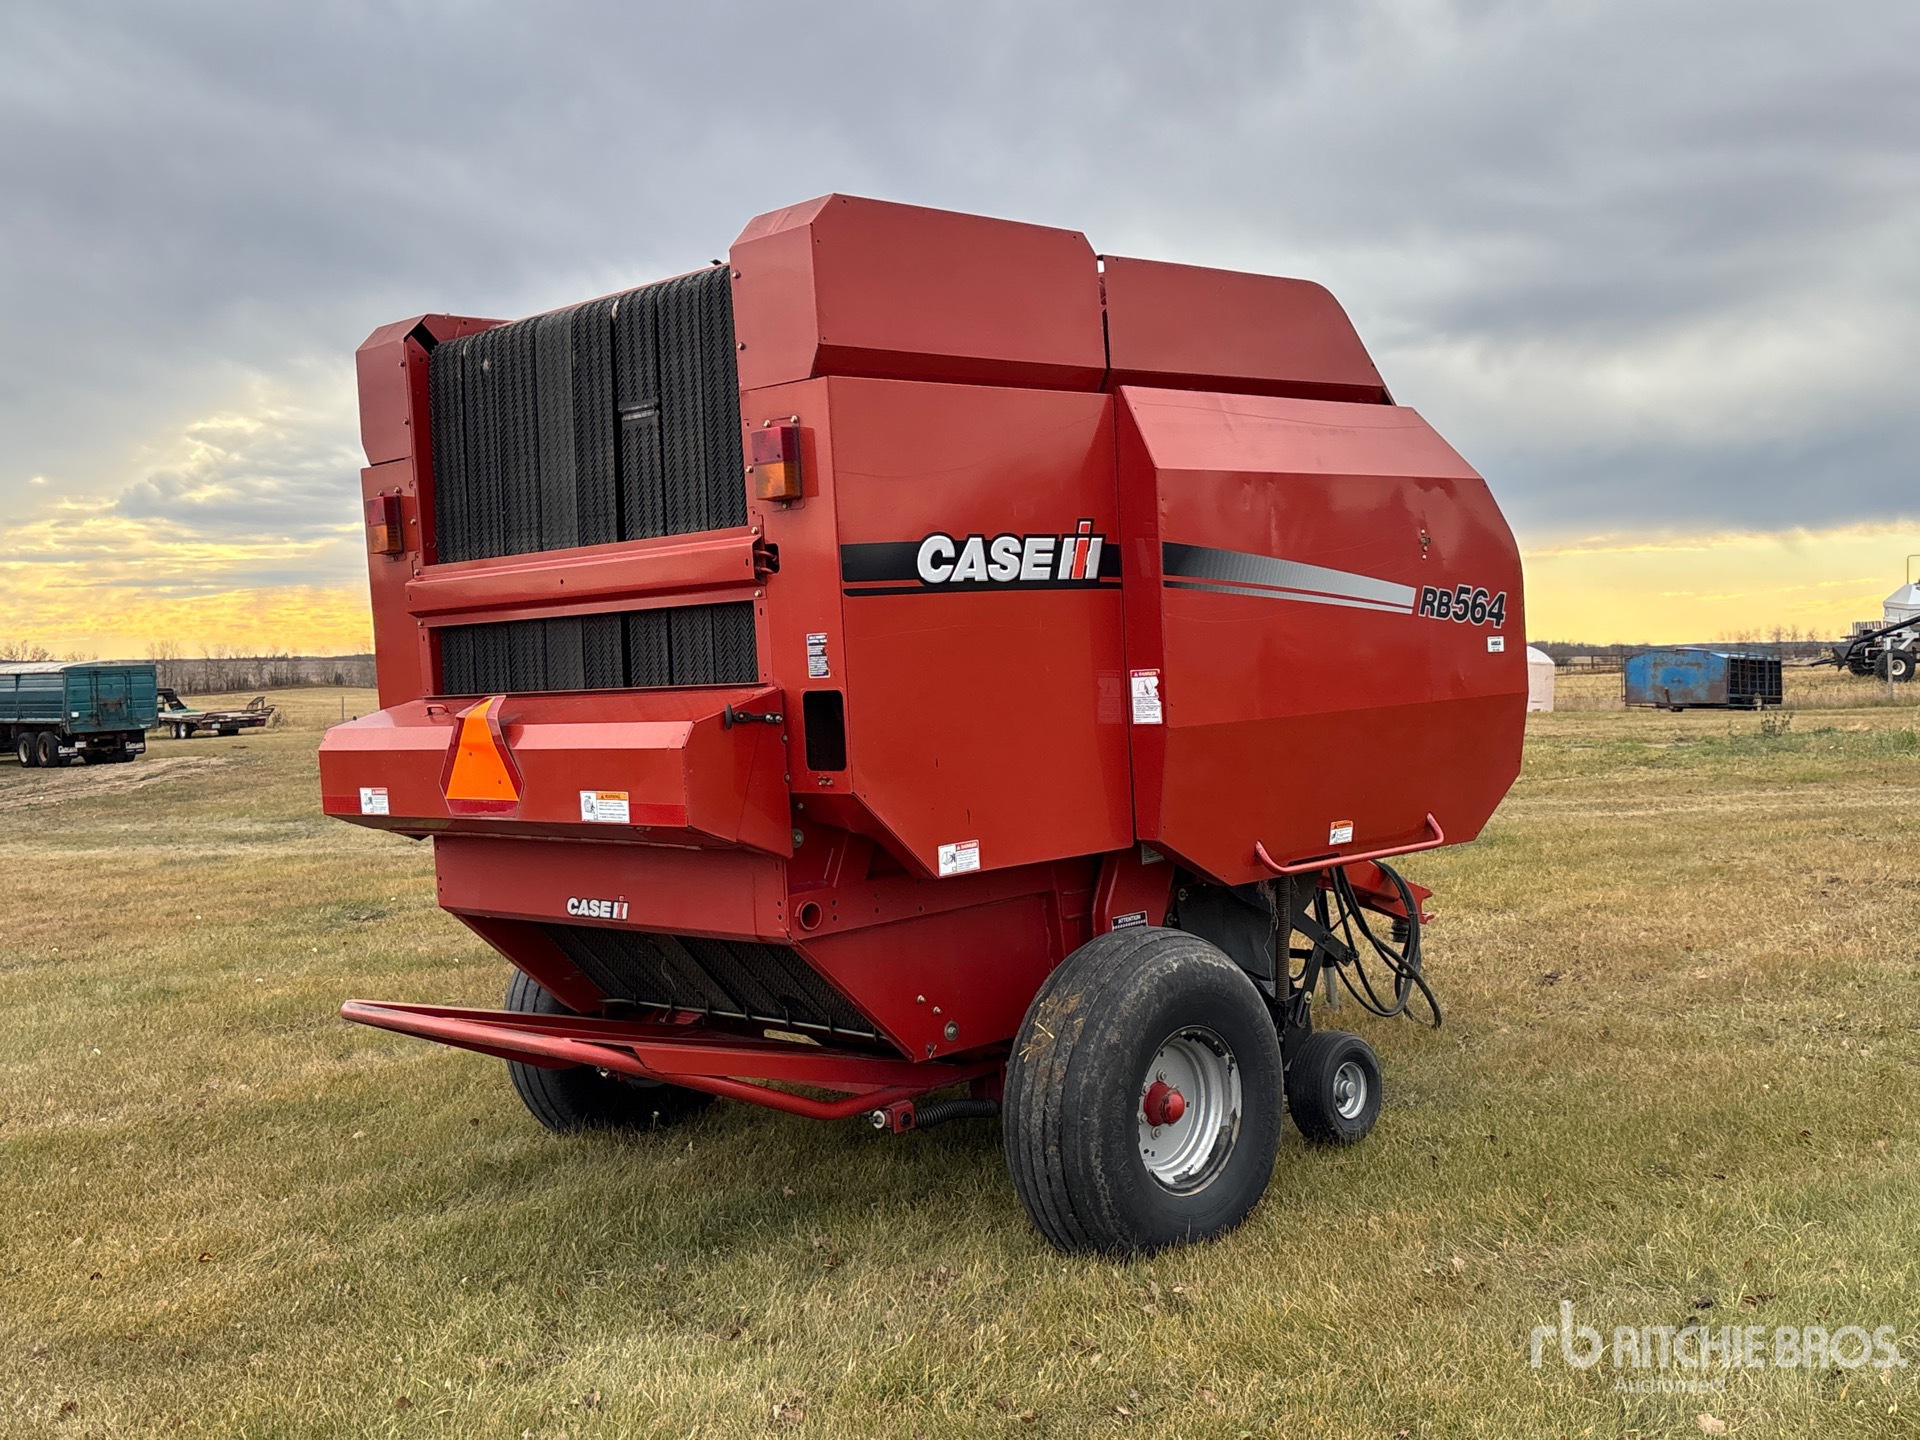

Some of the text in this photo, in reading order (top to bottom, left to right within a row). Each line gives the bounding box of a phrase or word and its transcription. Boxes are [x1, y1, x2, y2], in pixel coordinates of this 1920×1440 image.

[916, 534, 1056, 584] CASE
[1418, 583, 1507, 629] RB564
[566, 896, 612, 918] CASE
